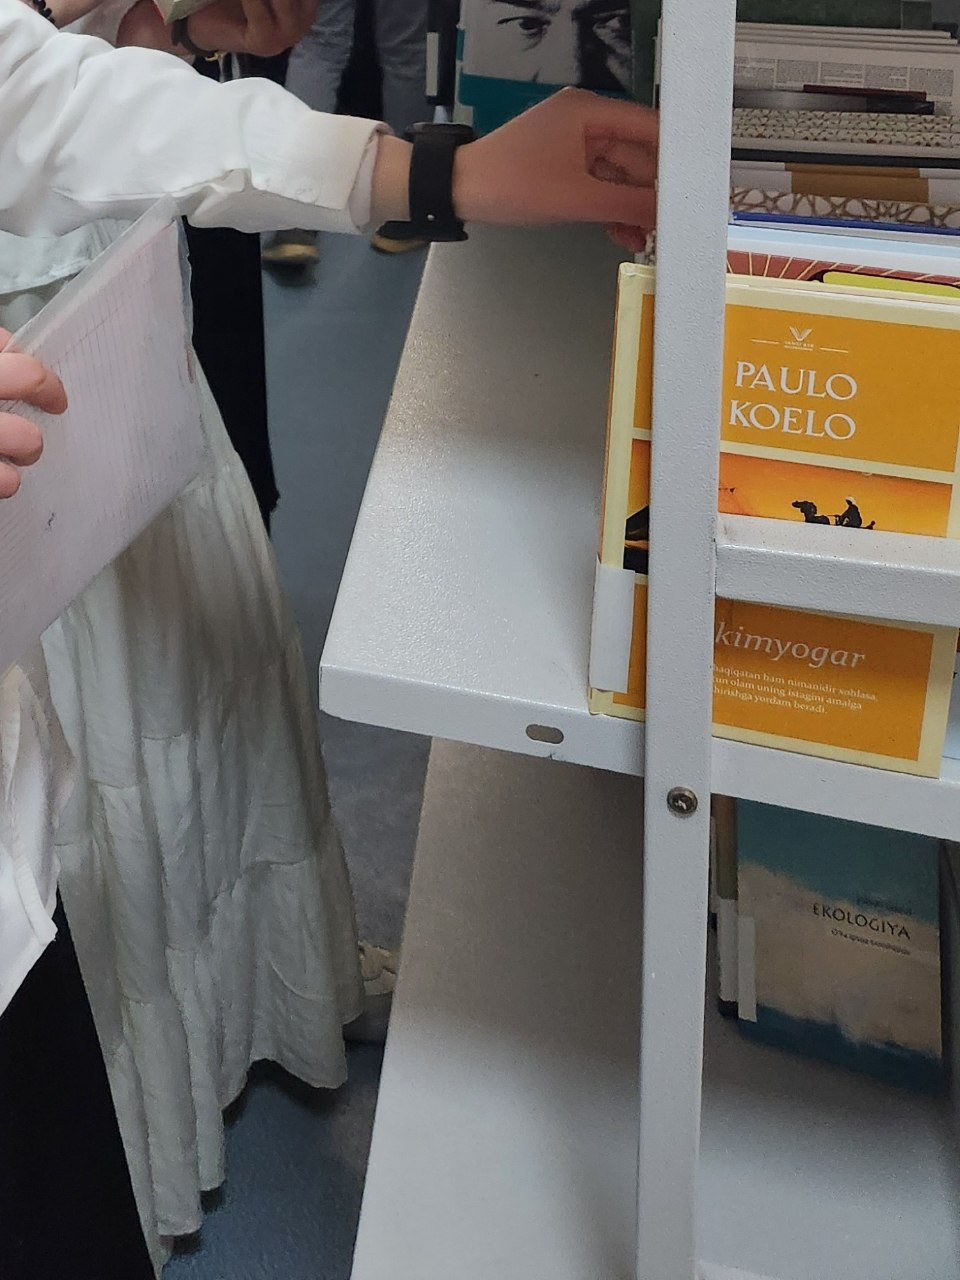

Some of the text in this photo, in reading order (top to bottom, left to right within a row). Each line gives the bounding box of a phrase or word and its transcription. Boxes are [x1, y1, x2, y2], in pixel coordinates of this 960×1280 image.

[735, 361, 858, 401] PAULO
[728, 400, 856, 440] KOELO
[715, 622, 865, 668] kimyogar
[713, 686, 828, 715] hirishga yordam beradi.
[730, 678, 755, 690] olam
[757, 684, 785, 697] uning
[826, 696, 862, 710] amalga
[763, 673, 785, 685] ham
[788, 679, 837, 694] nimanidir
[813, 902, 911, 940] EKOLOGIYA
